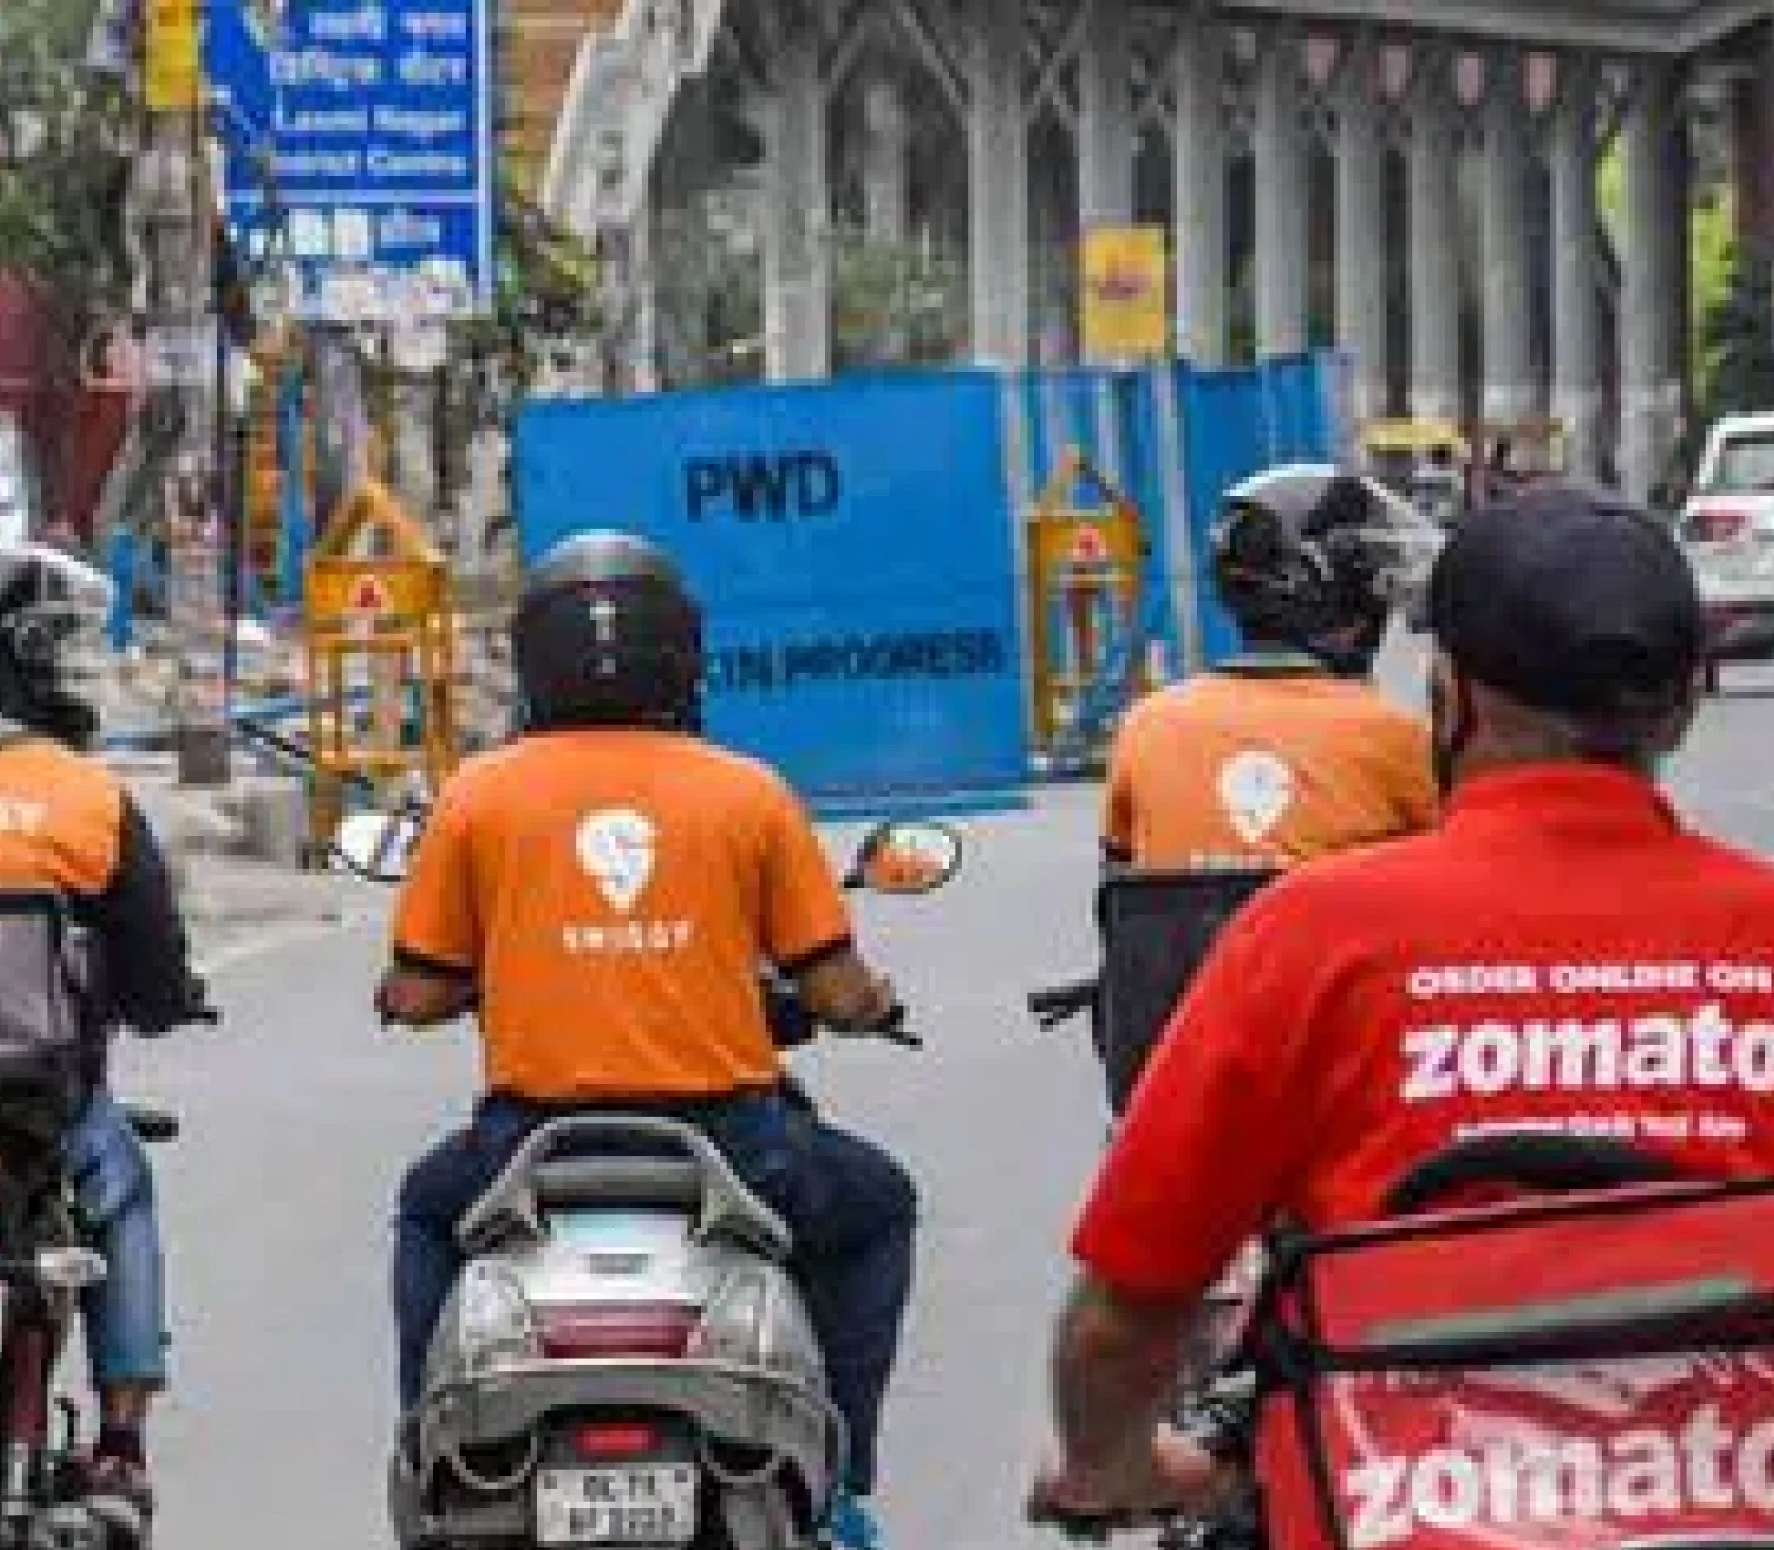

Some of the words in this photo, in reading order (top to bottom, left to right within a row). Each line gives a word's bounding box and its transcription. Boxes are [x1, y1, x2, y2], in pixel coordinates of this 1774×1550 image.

[682, 450, 839, 522] PWD
[1410, 966, 1537, 999] ORDER
[1549, 962, 1700, 994] ONLINE
[1705, 962, 1774, 992] ON
